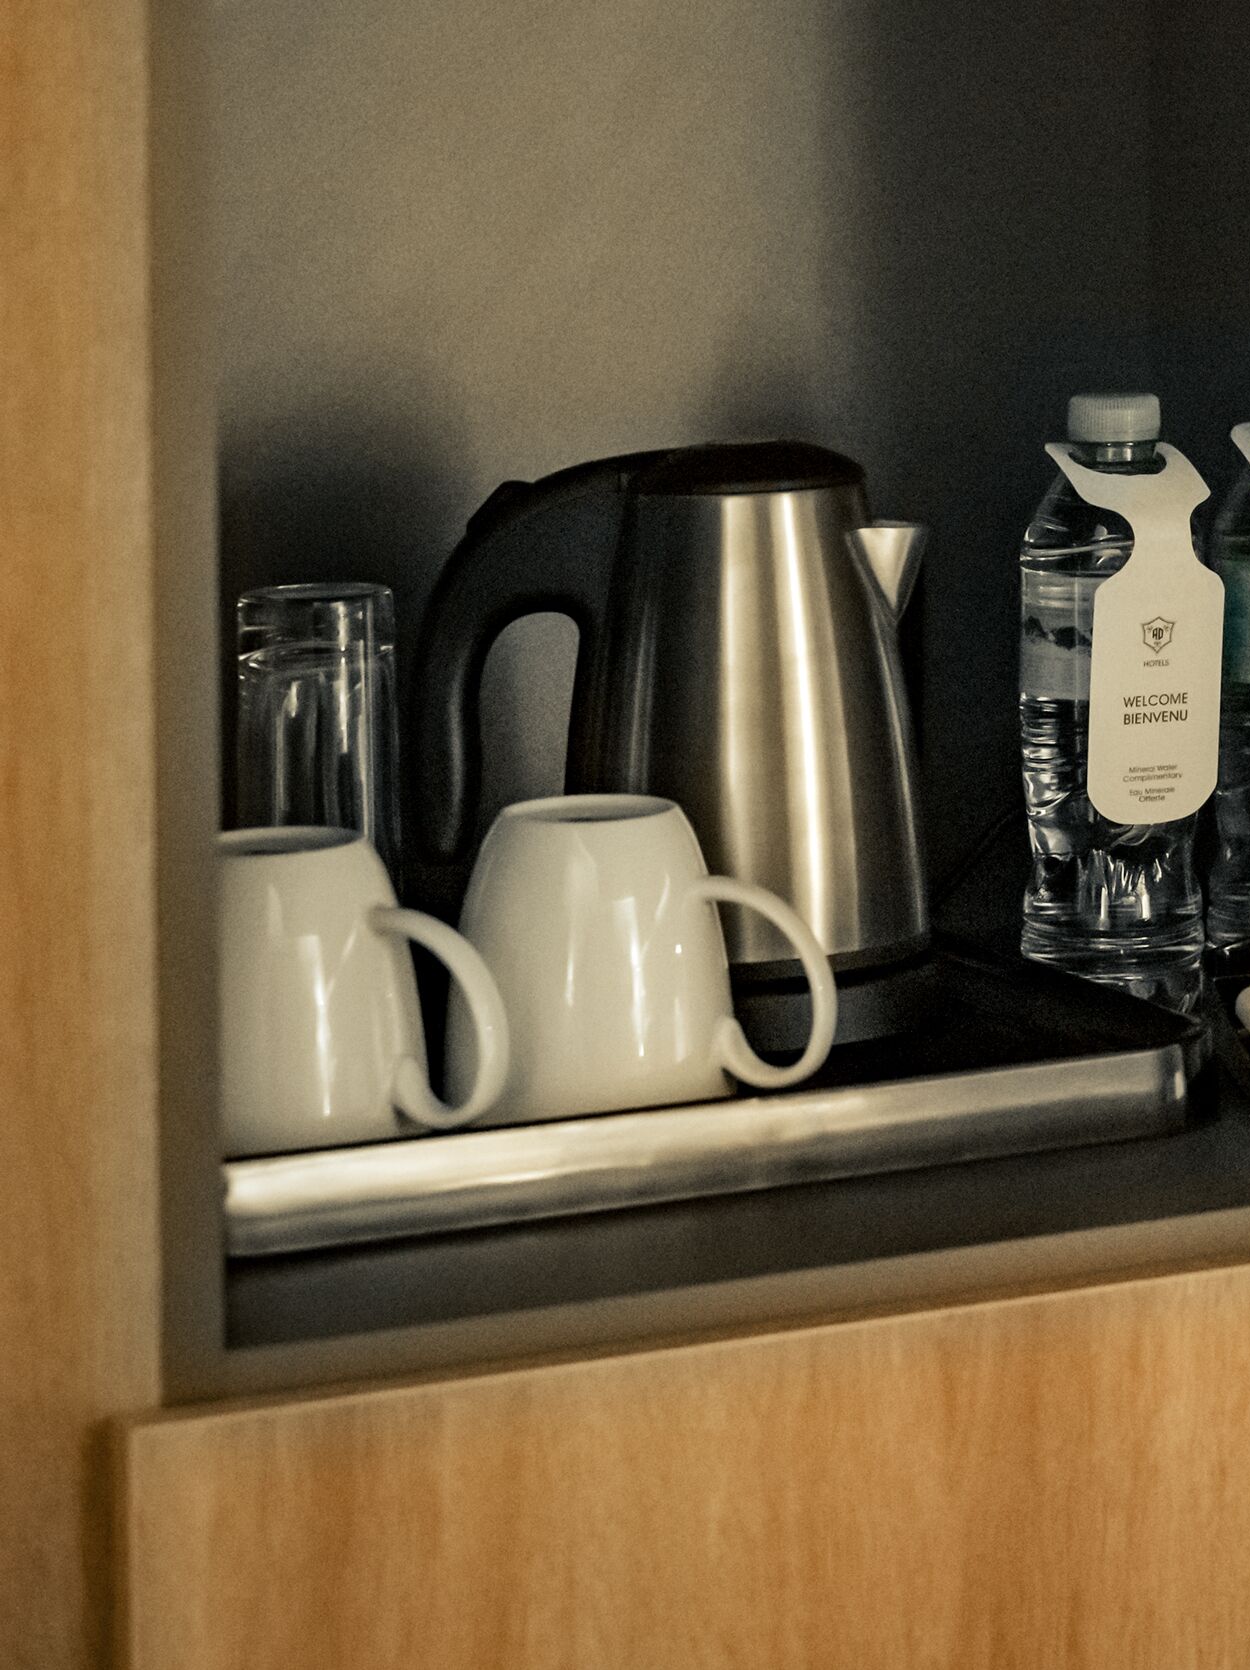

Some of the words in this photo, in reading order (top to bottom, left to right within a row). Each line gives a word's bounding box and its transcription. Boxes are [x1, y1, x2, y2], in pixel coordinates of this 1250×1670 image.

[1143, 659, 1169, 667] HOTELS
[1123, 693, 1188, 708] WELCOME
[1123, 709, 1188, 725] BIENVENU
[1122, 772, 1182, 782] Complimentary
